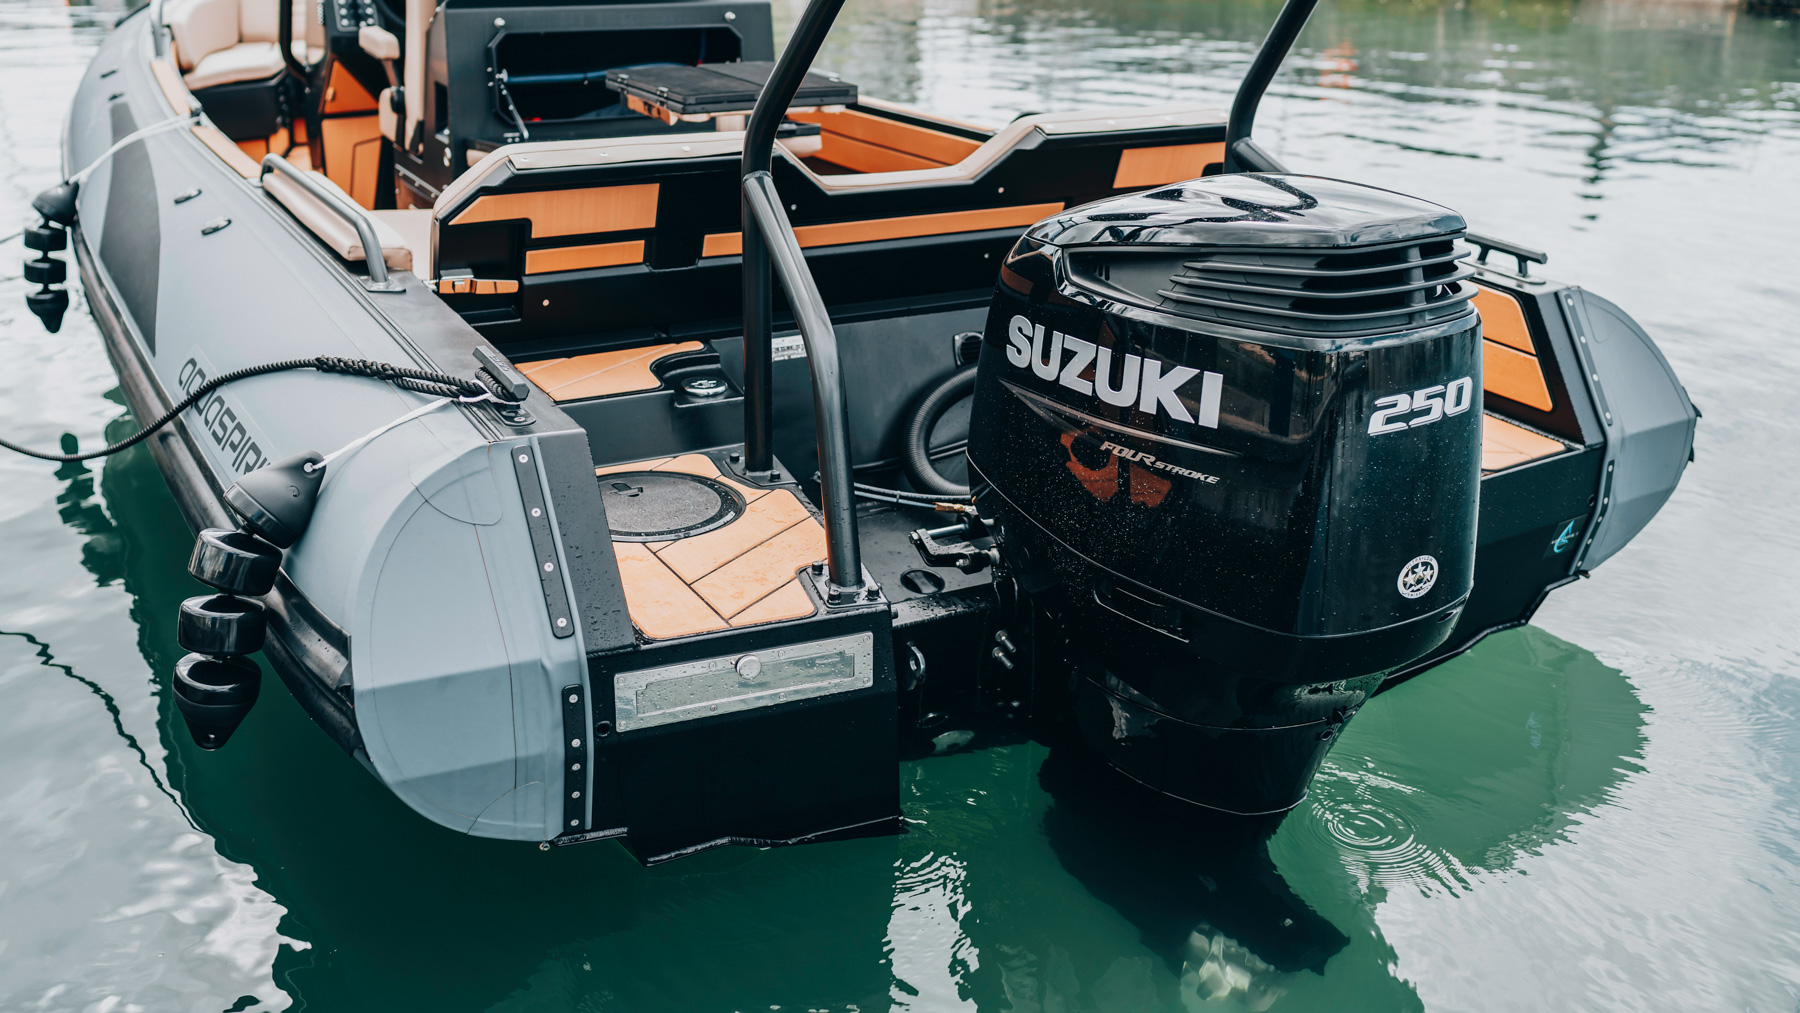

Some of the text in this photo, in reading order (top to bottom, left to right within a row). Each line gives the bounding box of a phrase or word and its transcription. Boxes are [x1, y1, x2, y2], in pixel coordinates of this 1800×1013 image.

[1006, 314, 1223, 429] SUZUKI
[1367, 376, 1473, 436] 250
[178, 357, 271, 475] AQUASPIR
[1099, 440, 1220, 484] FOUR STROKE
